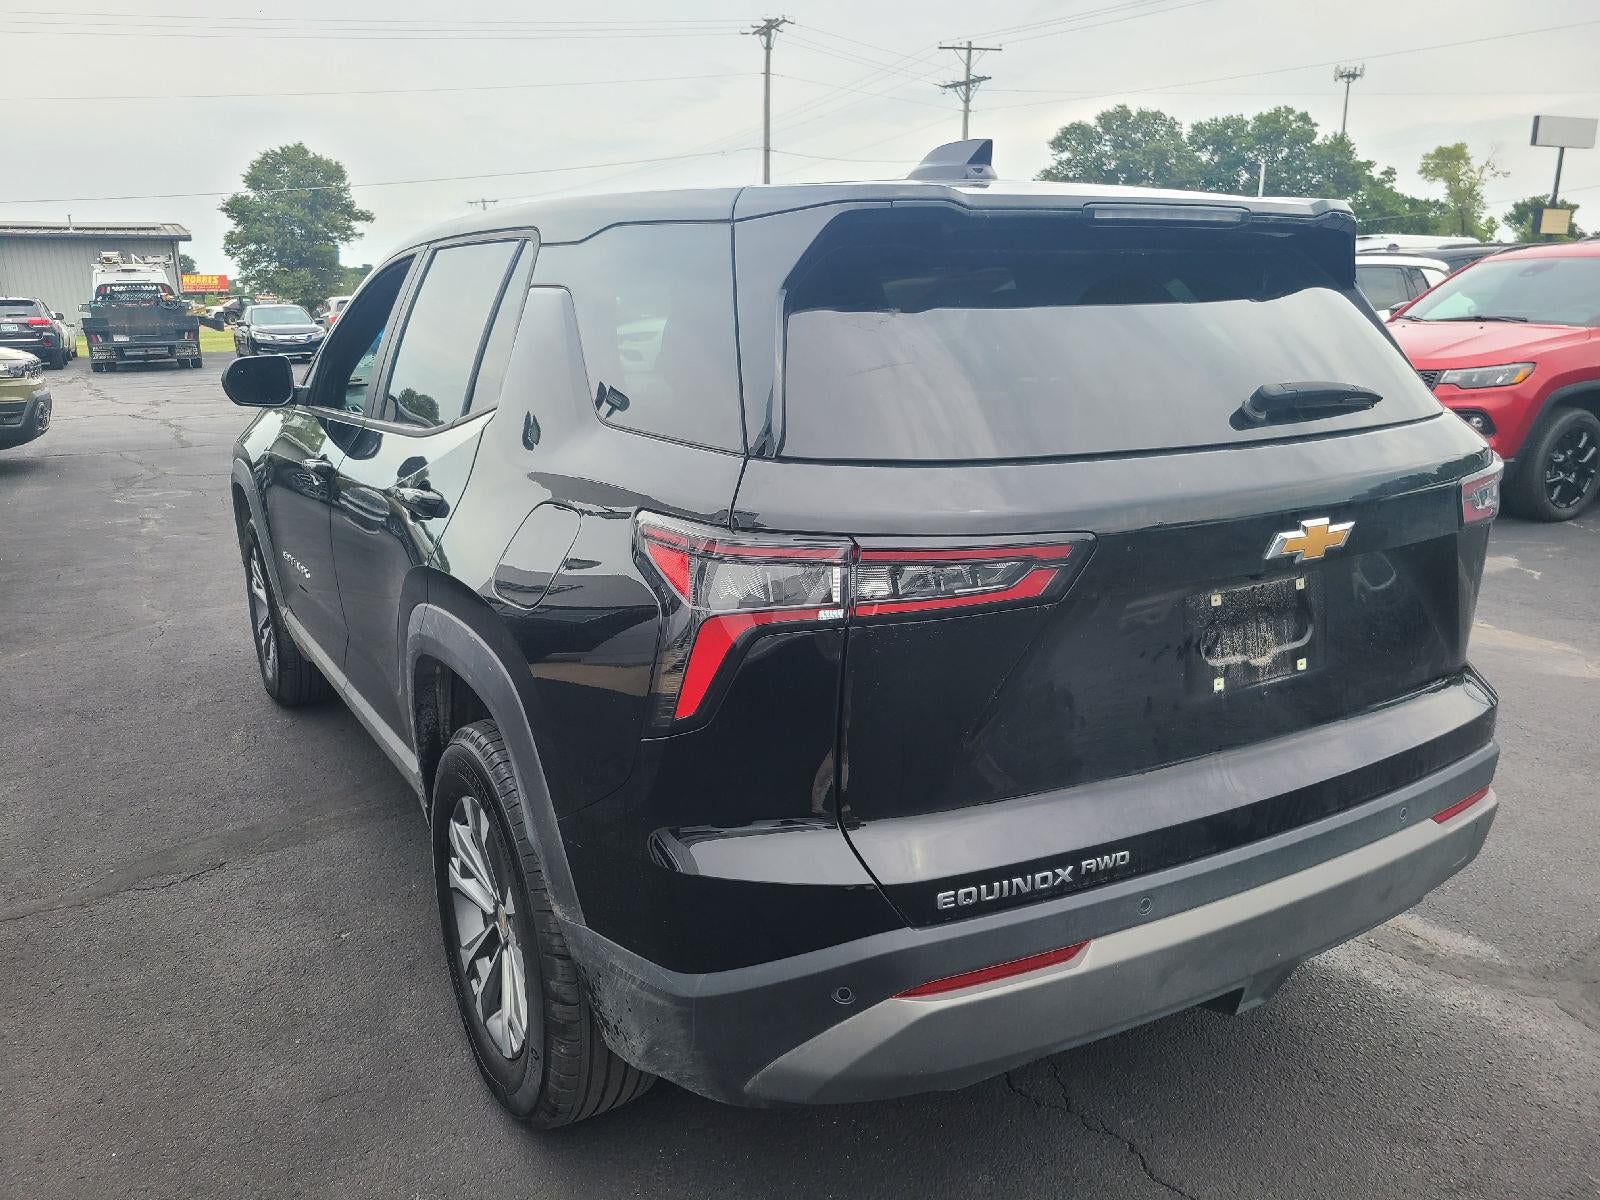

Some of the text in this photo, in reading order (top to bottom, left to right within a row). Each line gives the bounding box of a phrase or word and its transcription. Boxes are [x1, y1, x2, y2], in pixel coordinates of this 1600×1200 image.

[182, 275, 219, 285] NORRIS
[937, 850, 1130, 910] EQUINOX AWD
